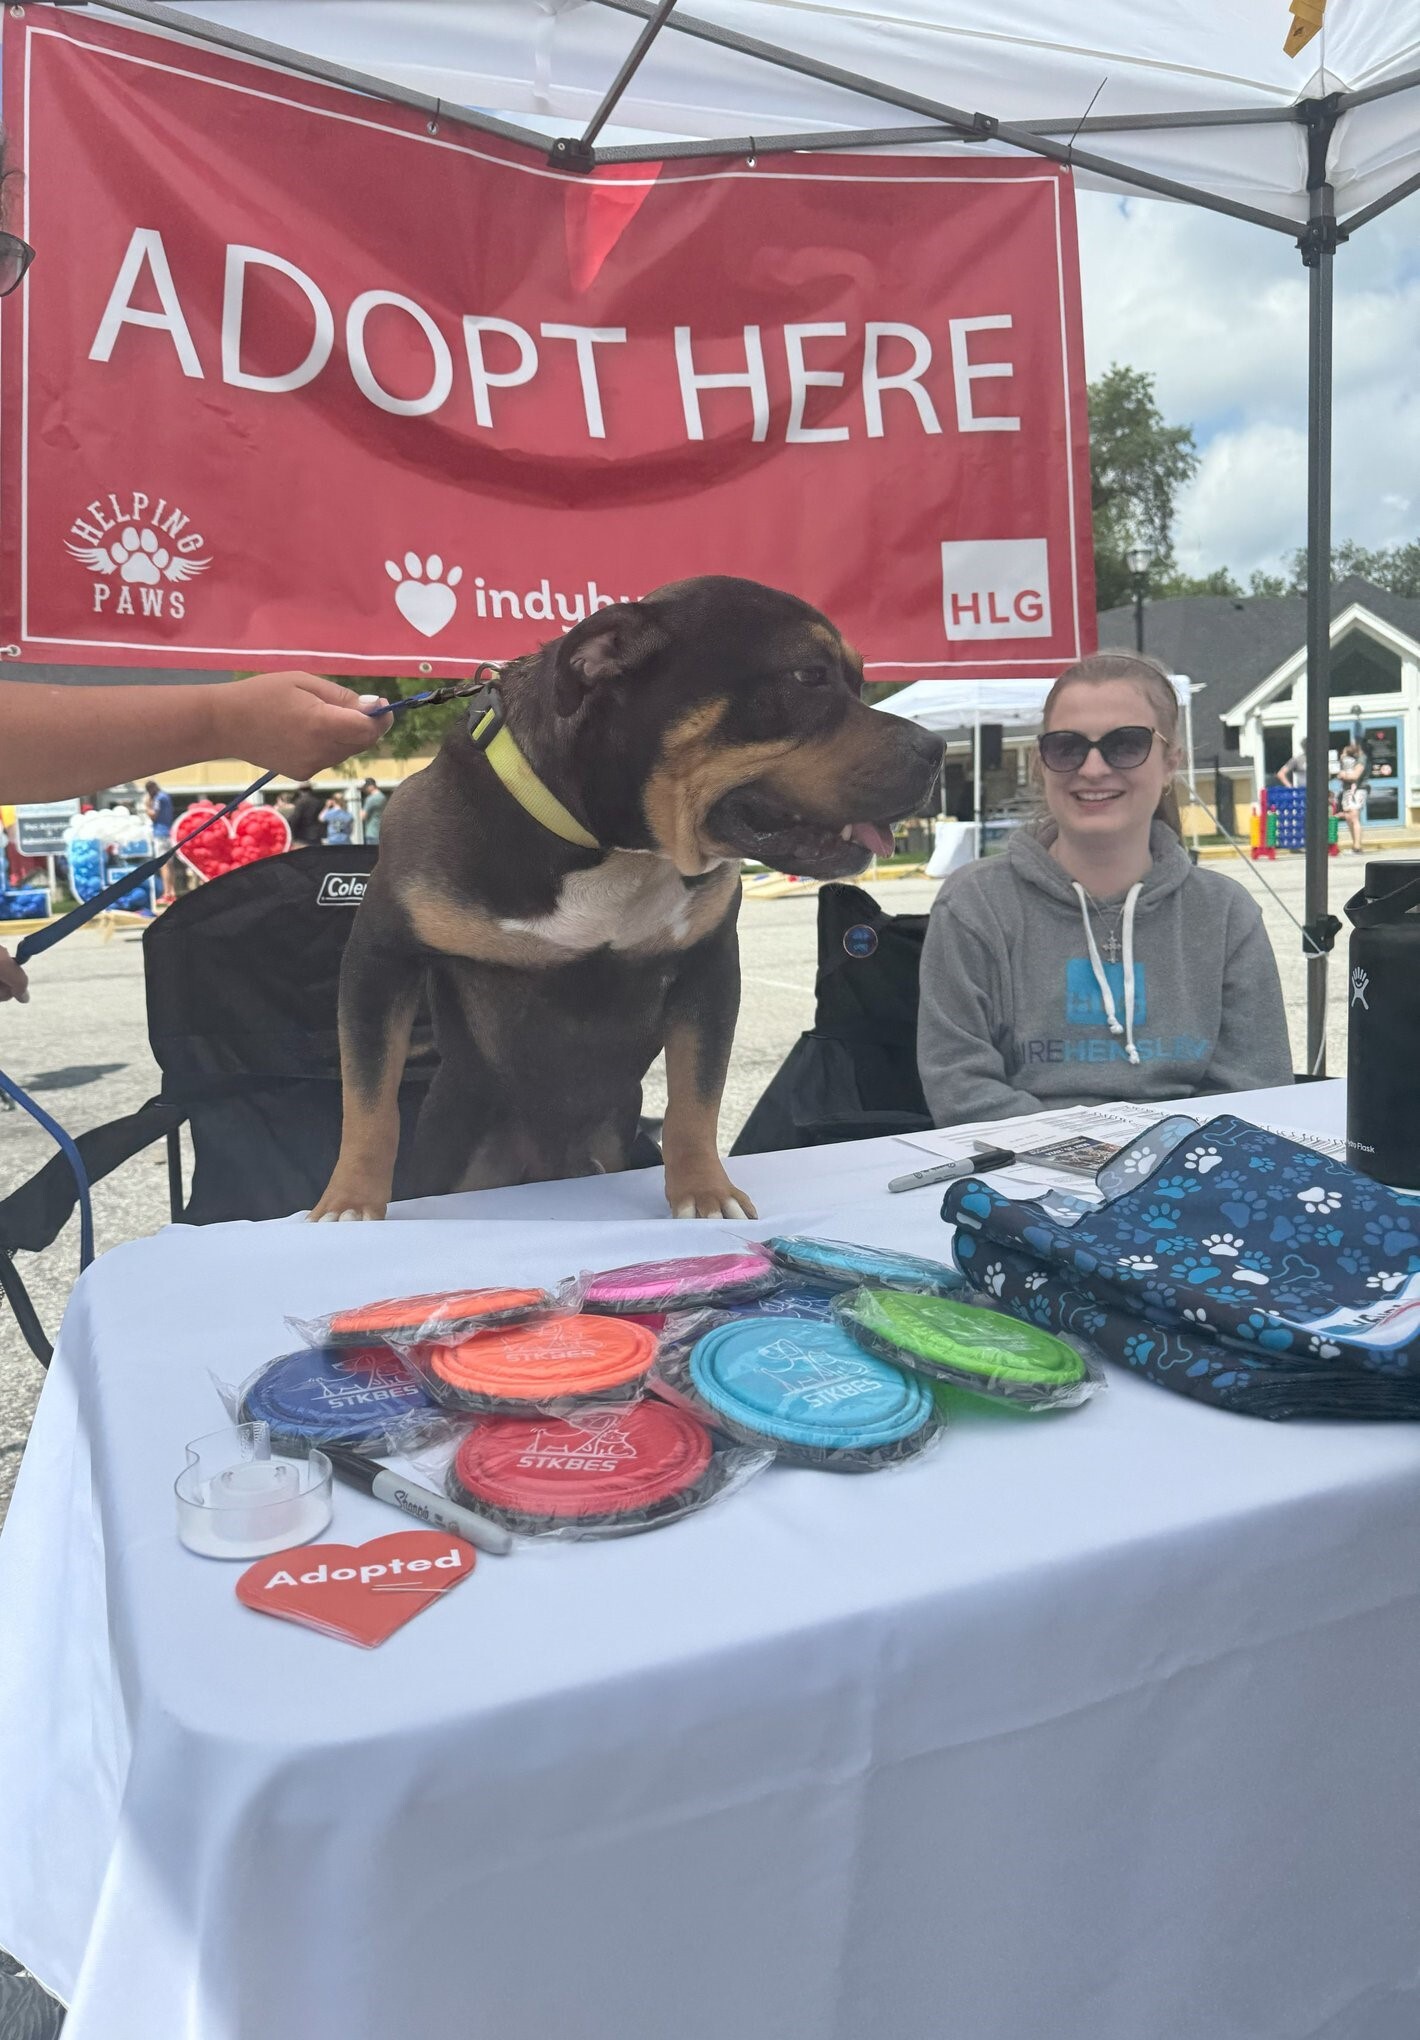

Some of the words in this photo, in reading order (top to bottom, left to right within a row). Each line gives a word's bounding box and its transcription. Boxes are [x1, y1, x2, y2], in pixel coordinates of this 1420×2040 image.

[89, 227, 627, 439] ADOPT
[674, 314, 1021, 443] HERE
[70, 491, 204, 553] HELPING
[93, 583, 186, 619] PAWS
[951, 589, 1044, 626] HLG
[328, 877, 368, 897] Cole
[327, 1384, 419, 1409] STKBES
[802, 1378, 883, 1408] STKBES
[516, 1454, 618, 1473] STKBES
[264, 1549, 463, 1590] Adopted
